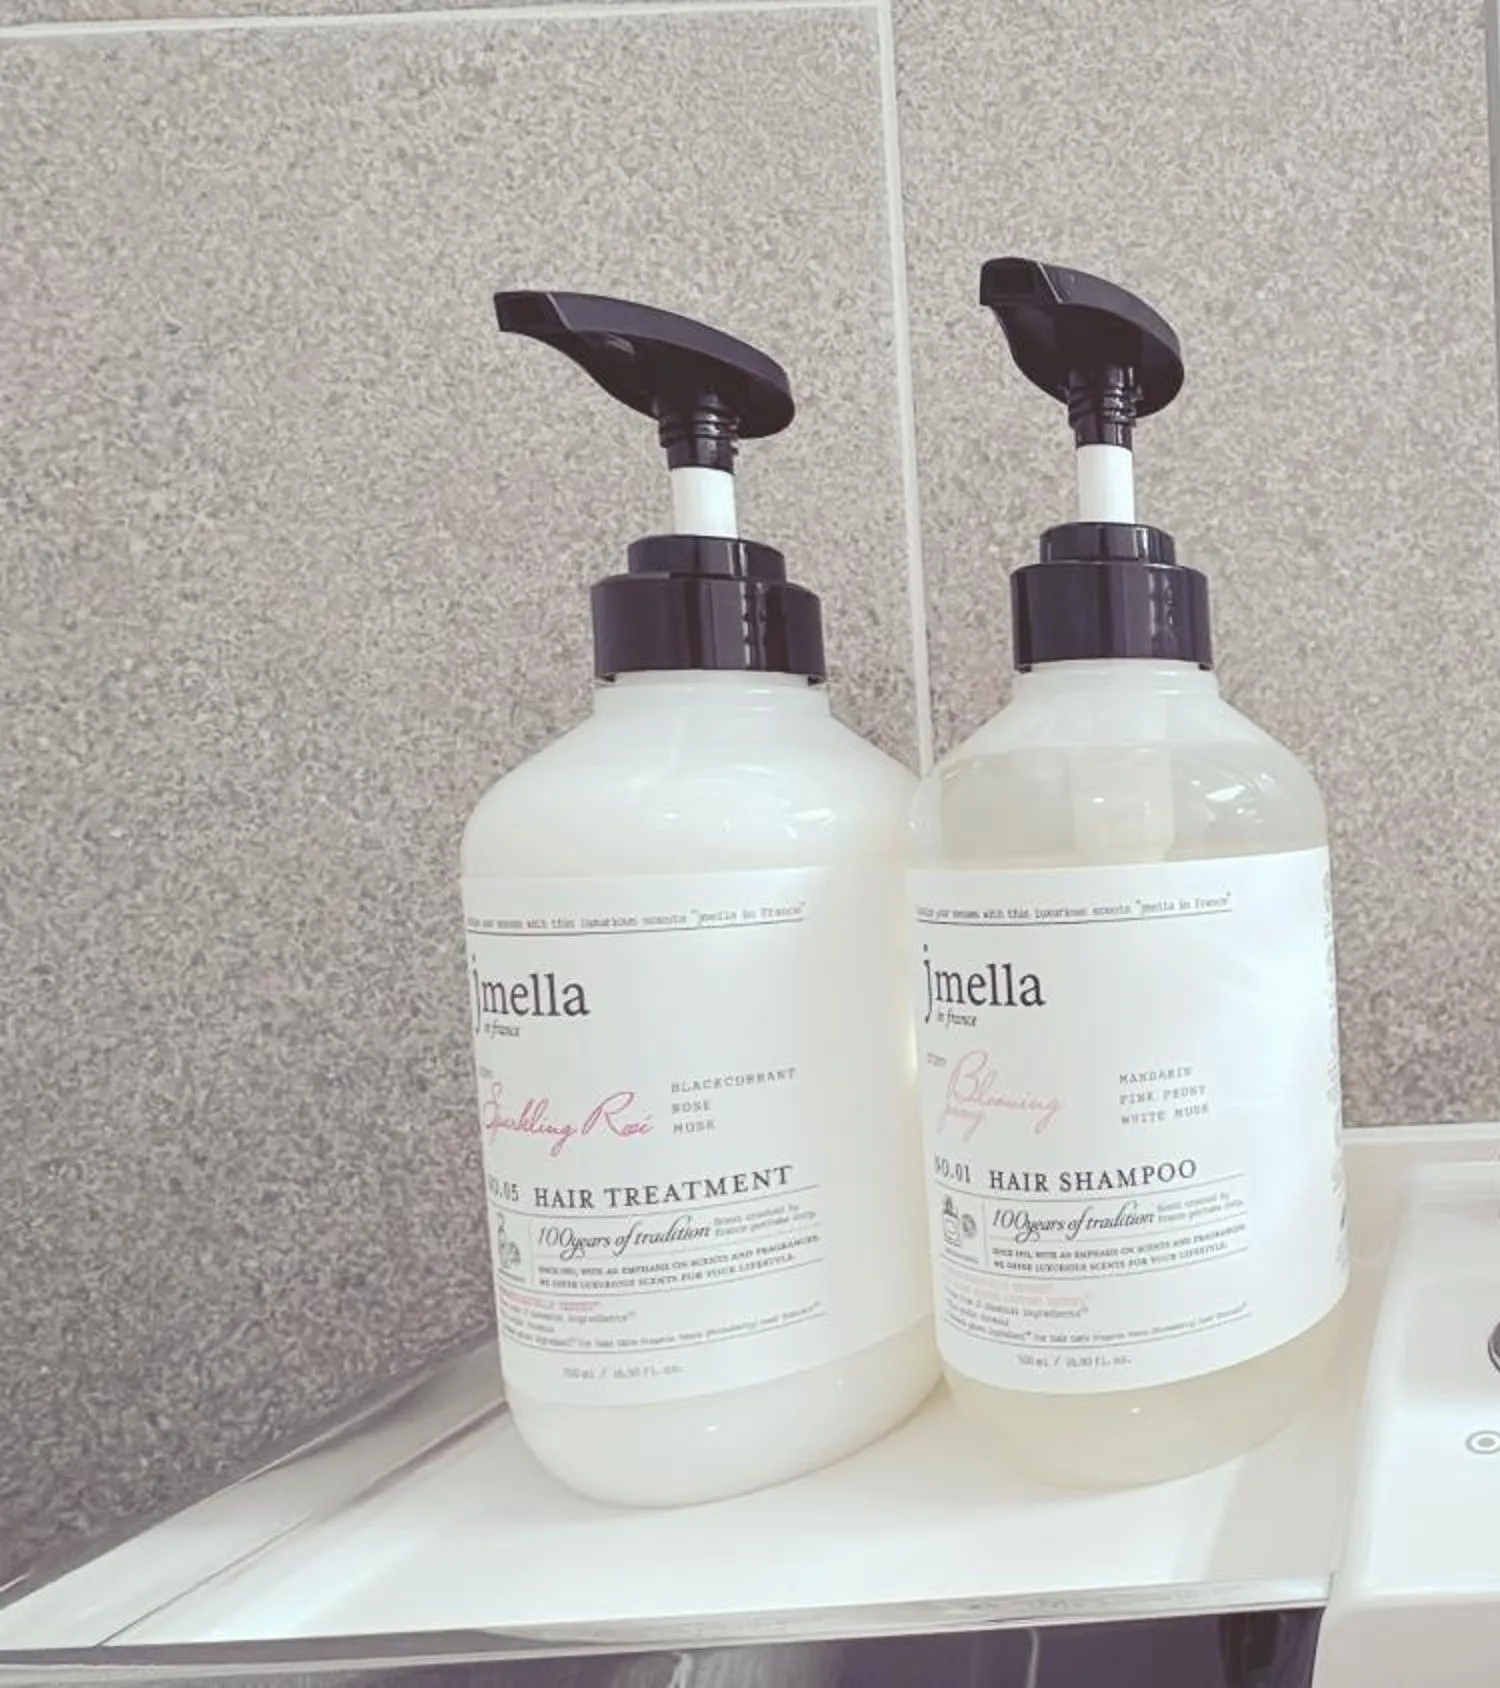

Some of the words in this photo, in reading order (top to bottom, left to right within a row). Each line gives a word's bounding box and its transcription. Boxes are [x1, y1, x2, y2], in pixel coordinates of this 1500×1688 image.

[471, 952, 592, 1037] jmella
[922, 943, 1048, 1025] jmella
[670, 1066, 797, 1094] BLACKCURRANT
[1119, 1065, 1193, 1084] MANDARIN
[670, 1099, 712, 1115] ROSE
[1119, 1091, 1155, 1105] PINK
[1162, 1084, 1207, 1101] PEONY
[672, 1119, 717, 1135] MUSK
[1121, 1109, 1166, 1125] WHITE
[1173, 1103, 1209, 1119] MUSK
[533, 1186, 596, 1209] HAIR
[603, 1164, 794, 1209] TREATMENT
[988, 1169, 1049, 1193] HAIR
[1059, 1158, 1197, 1193] SHAMPOO
[1084, 1198, 1155, 1231] tradition
[632, 1214, 712, 1246] tradition
[681, 1271, 703, 1282] FOR
